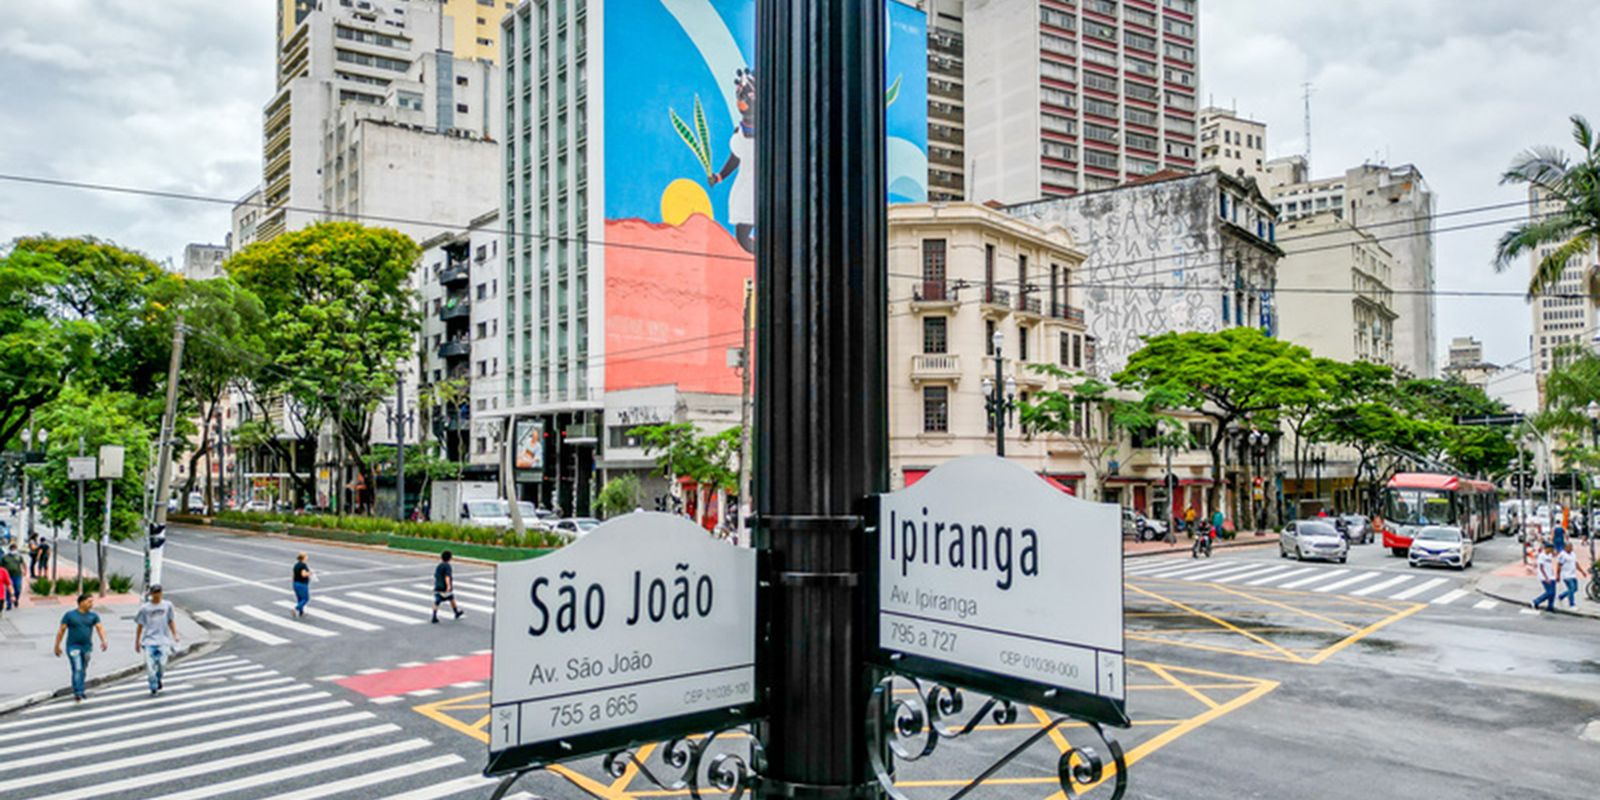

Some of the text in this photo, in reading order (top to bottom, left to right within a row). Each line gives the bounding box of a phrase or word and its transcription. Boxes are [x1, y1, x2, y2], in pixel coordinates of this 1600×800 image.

[890, 506, 1039, 591] Ipiranga
[528, 562, 713, 637] São João
[890, 584, 977, 619] Av. Ipiranga
[891, 622, 957, 652] 795 a 727
[529, 650, 653, 686] Av. São João
[999, 650, 1021, 667] CEP
[1107, 671, 1114, 692] 1
[550, 693, 639, 728] 755 a 665
[502, 723, 509, 743] 1
